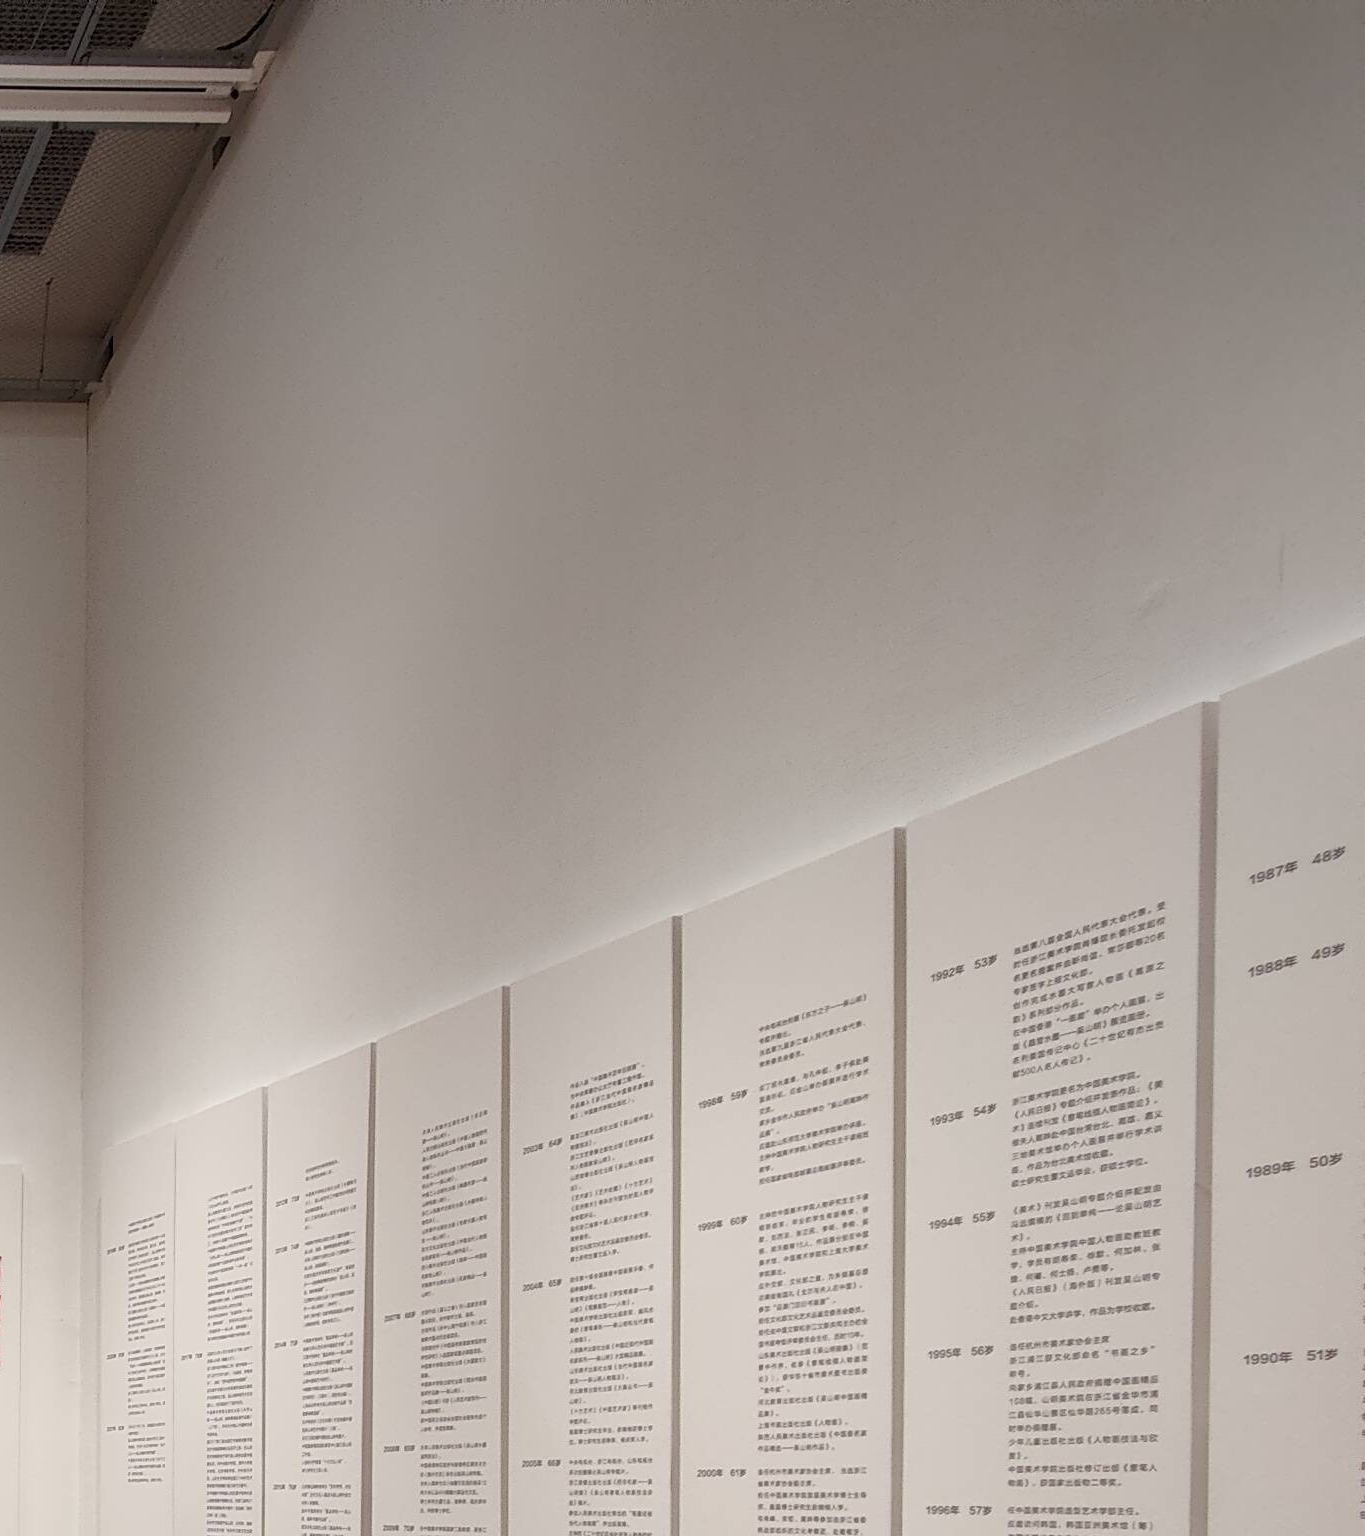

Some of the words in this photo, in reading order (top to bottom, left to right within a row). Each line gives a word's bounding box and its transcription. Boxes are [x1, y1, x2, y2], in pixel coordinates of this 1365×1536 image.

[1249, 861, 1298, 884] 1987年
[1312, 846, 1346, 864] 48岁
[931, 964, 965, 982] 1992年
[974, 954, 997, 969] 53岁
[1248, 956, 1298, 977] 1988年
[1311, 943, 1345, 959] 49岁
[930, 1111, 964, 1126] 1993年
[974, 1104, 996, 1116] 54岁
[1246, 1161, 1295, 1178] 1989年
[1309, 1153, 1343, 1168] 50岁
[929, 1216, 963, 1229] 1994年
[973, 1211, 995, 1223] 55岁
[928, 1348, 961, 1359] 1995年
[971, 1345, 994, 1356] 56岁
[1243, 1352, 1293, 1365] 1990年
[1307, 1348, 1338, 1361] 51岁
[926, 1505, 960, 1515] 1996年
[969, 1506, 992, 1515] 57岁
